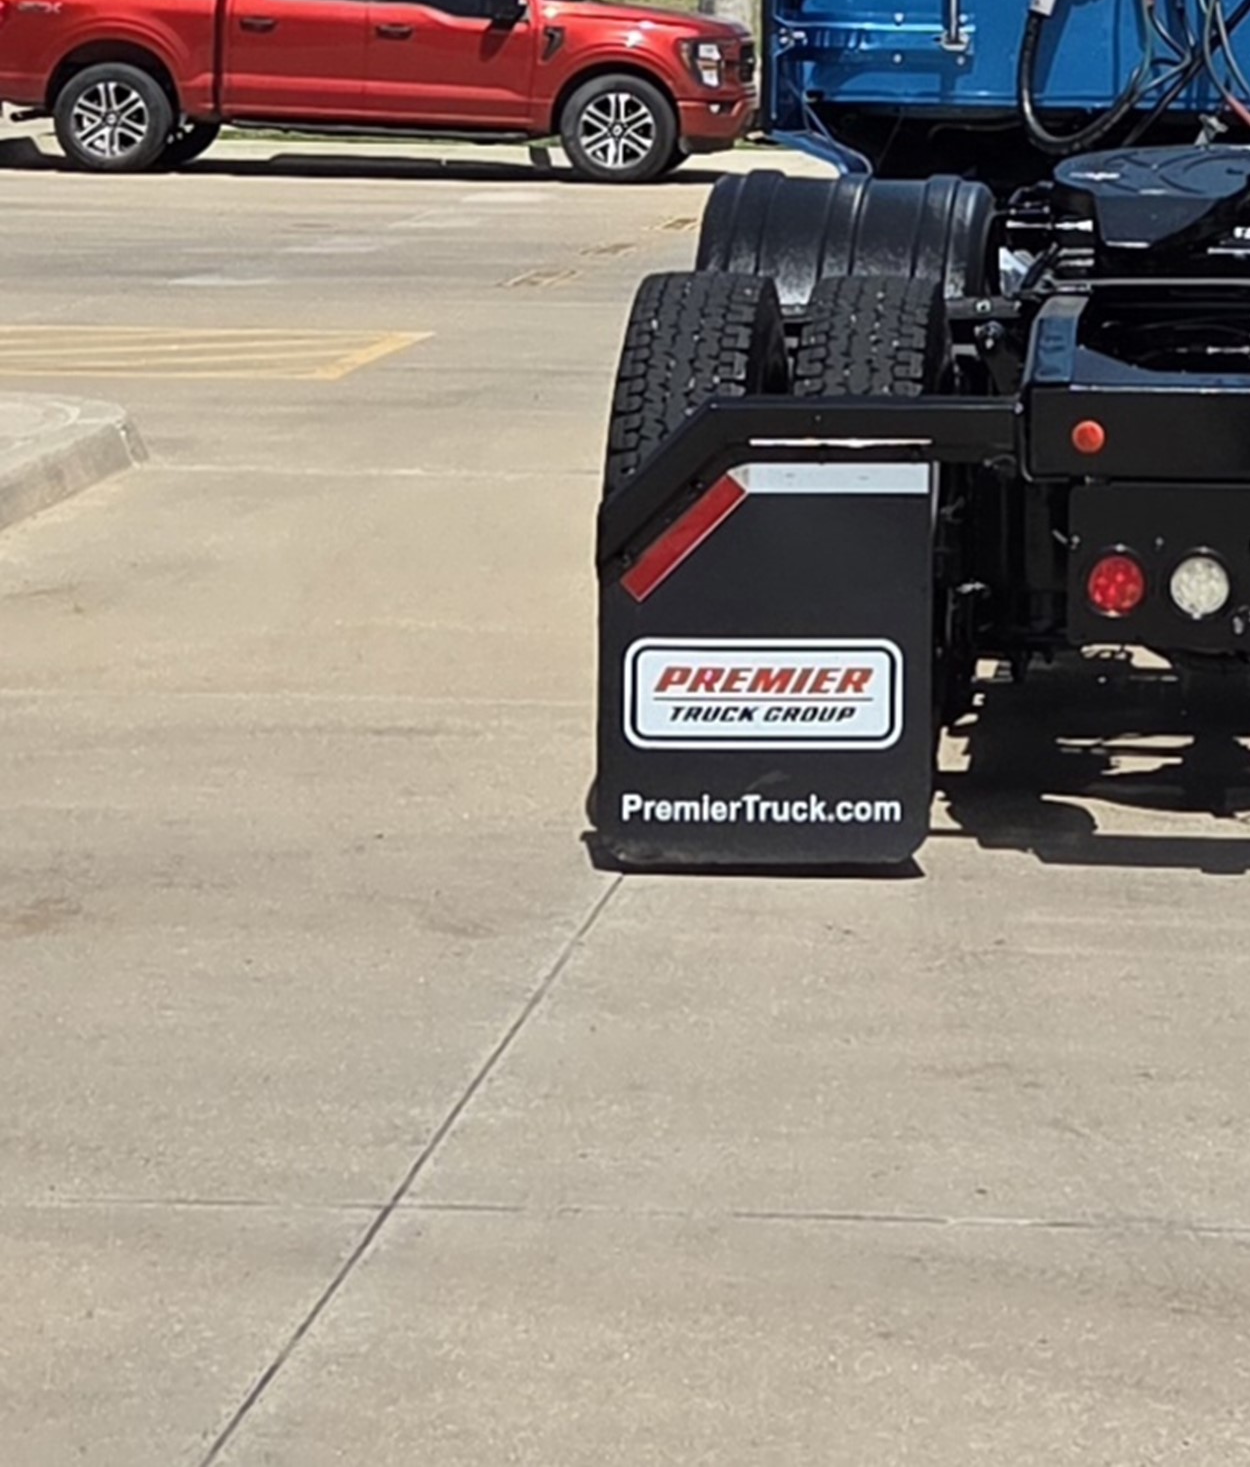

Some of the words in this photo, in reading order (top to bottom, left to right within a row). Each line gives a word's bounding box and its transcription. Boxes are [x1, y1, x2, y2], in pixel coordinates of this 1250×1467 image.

[653, 665, 875, 694] PREMIER
[669, 706, 759, 723] TRUCK
[762, 706, 857, 723] GROUP
[621, 793, 902, 822] PremierTruck.com
